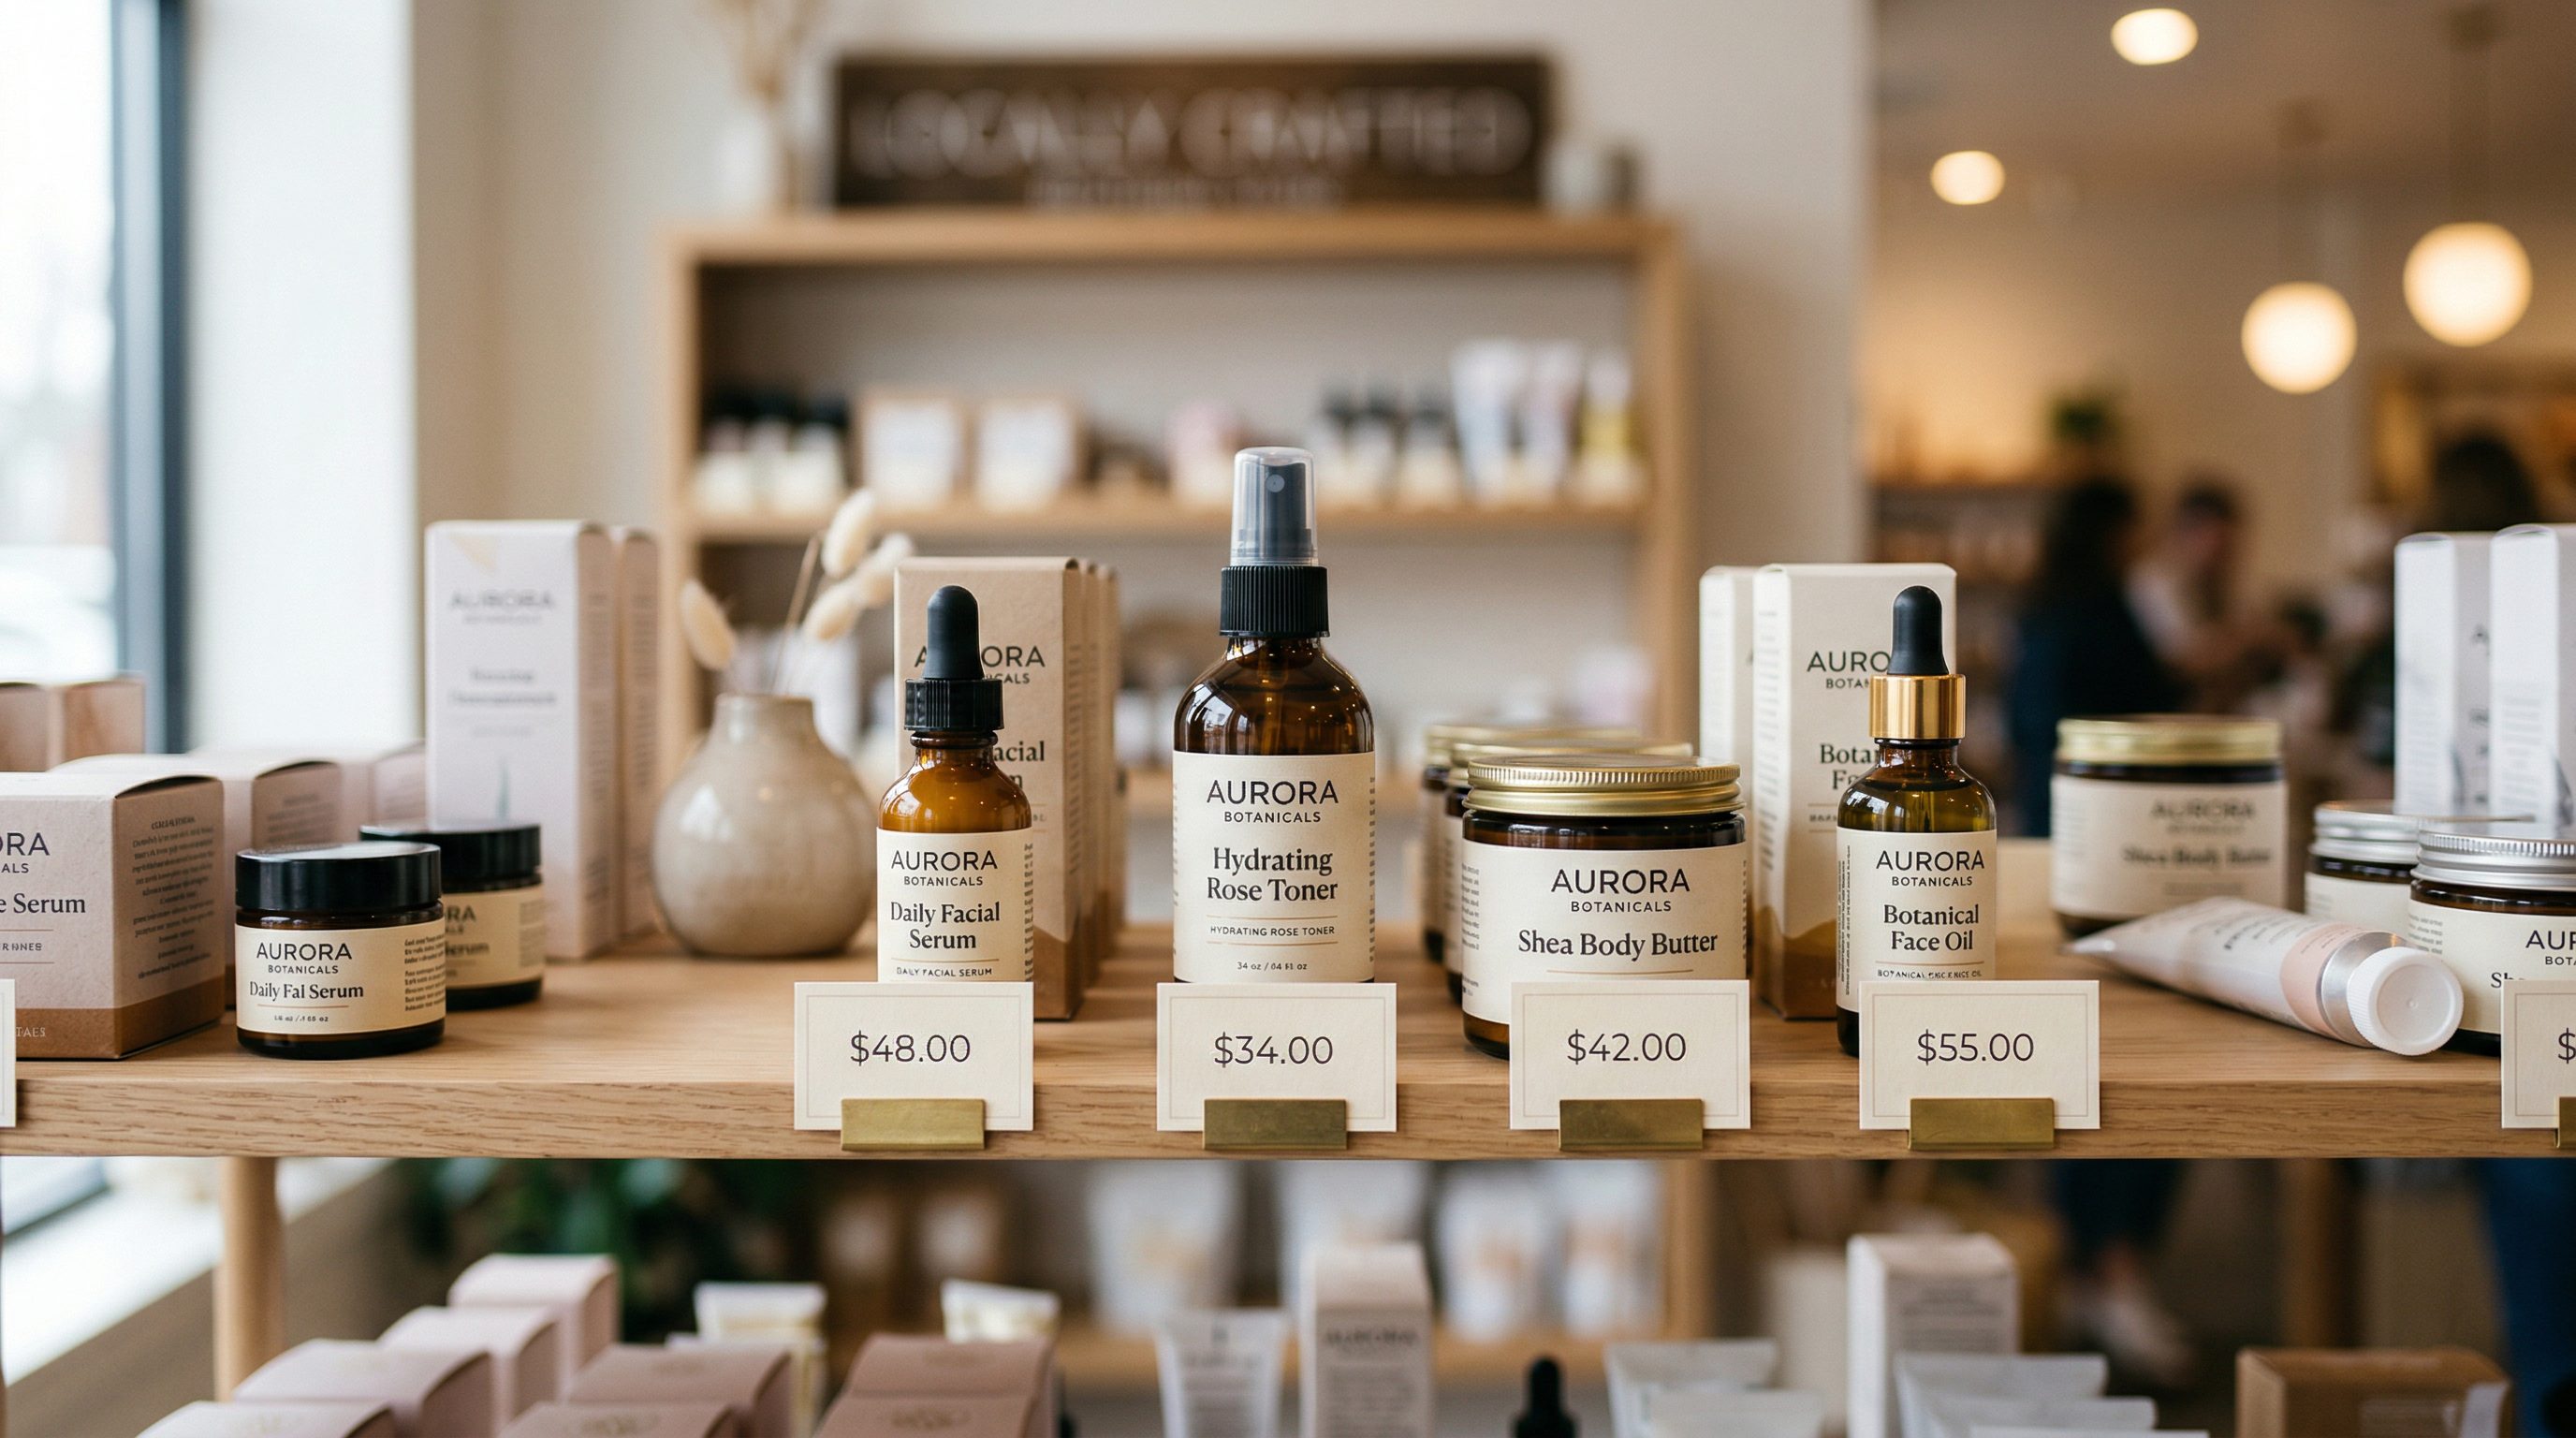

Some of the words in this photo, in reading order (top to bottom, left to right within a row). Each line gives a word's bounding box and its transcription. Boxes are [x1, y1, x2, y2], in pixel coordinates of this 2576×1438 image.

[915, 645, 1046, 667] AORA
[1807, 651, 1891, 673] AURO
[992, 741, 1045, 762] acial
[1206, 779, 1339, 806] AURORA
[1223, 811, 1322, 824] BOTANICALS
[0, 831, 51, 856] RA
[891, 849, 998, 872] AURORA
[1213, 846, 1334, 876] Hydrating
[1875, 849, 1985, 872] AURORA
[903, 875, 984, 887] BOTANICALS
[1207, 876, 1263, 901] Rose
[1266, 878, 1339, 902] Toner
[1550, 868, 1690, 894] AURORA
[1891, 875, 1973, 888] BOTANICALS
[13, 892, 86, 914] Serum
[1571, 900, 1672, 913] BOTANICALS
[890, 901, 936, 928] Daily
[941, 901, 1001, 924] Facial
[1883, 903, 1980, 926] Botanical
[909, 928, 976, 949] Serum
[1210, 925, 1268, 937] HYDRATING
[1270, 927, 1299, 937] ROSE
[1302, 926, 1335, 936] TONER
[1891, 930, 1940, 952] Face
[1944, 929, 1973, 951] Oil
[256, 942, 353, 961] AURORA
[1518, 930, 1574, 955] Shea
[1579, 932, 1647, 961] Body
[1651, 932, 1720, 956] Butter
[268, 964, 339, 975] BOTANICALS
[2544, 955, 2576, 966] BOT
[922, 968, 957, 977] FACIAL
[959, 967, 992, 977] SERUM
[249, 980, 281, 1002] Daily
[283, 983, 306, 999] Fal
[309, 984, 365, 999] Serum
[850, 1030, 971, 1066] $48.00
[1214, 1032, 1334, 1068] $34.00
[1567, 1029, 1687, 1065] $42.00
[1917, 1029, 2034, 1065] $55.00
